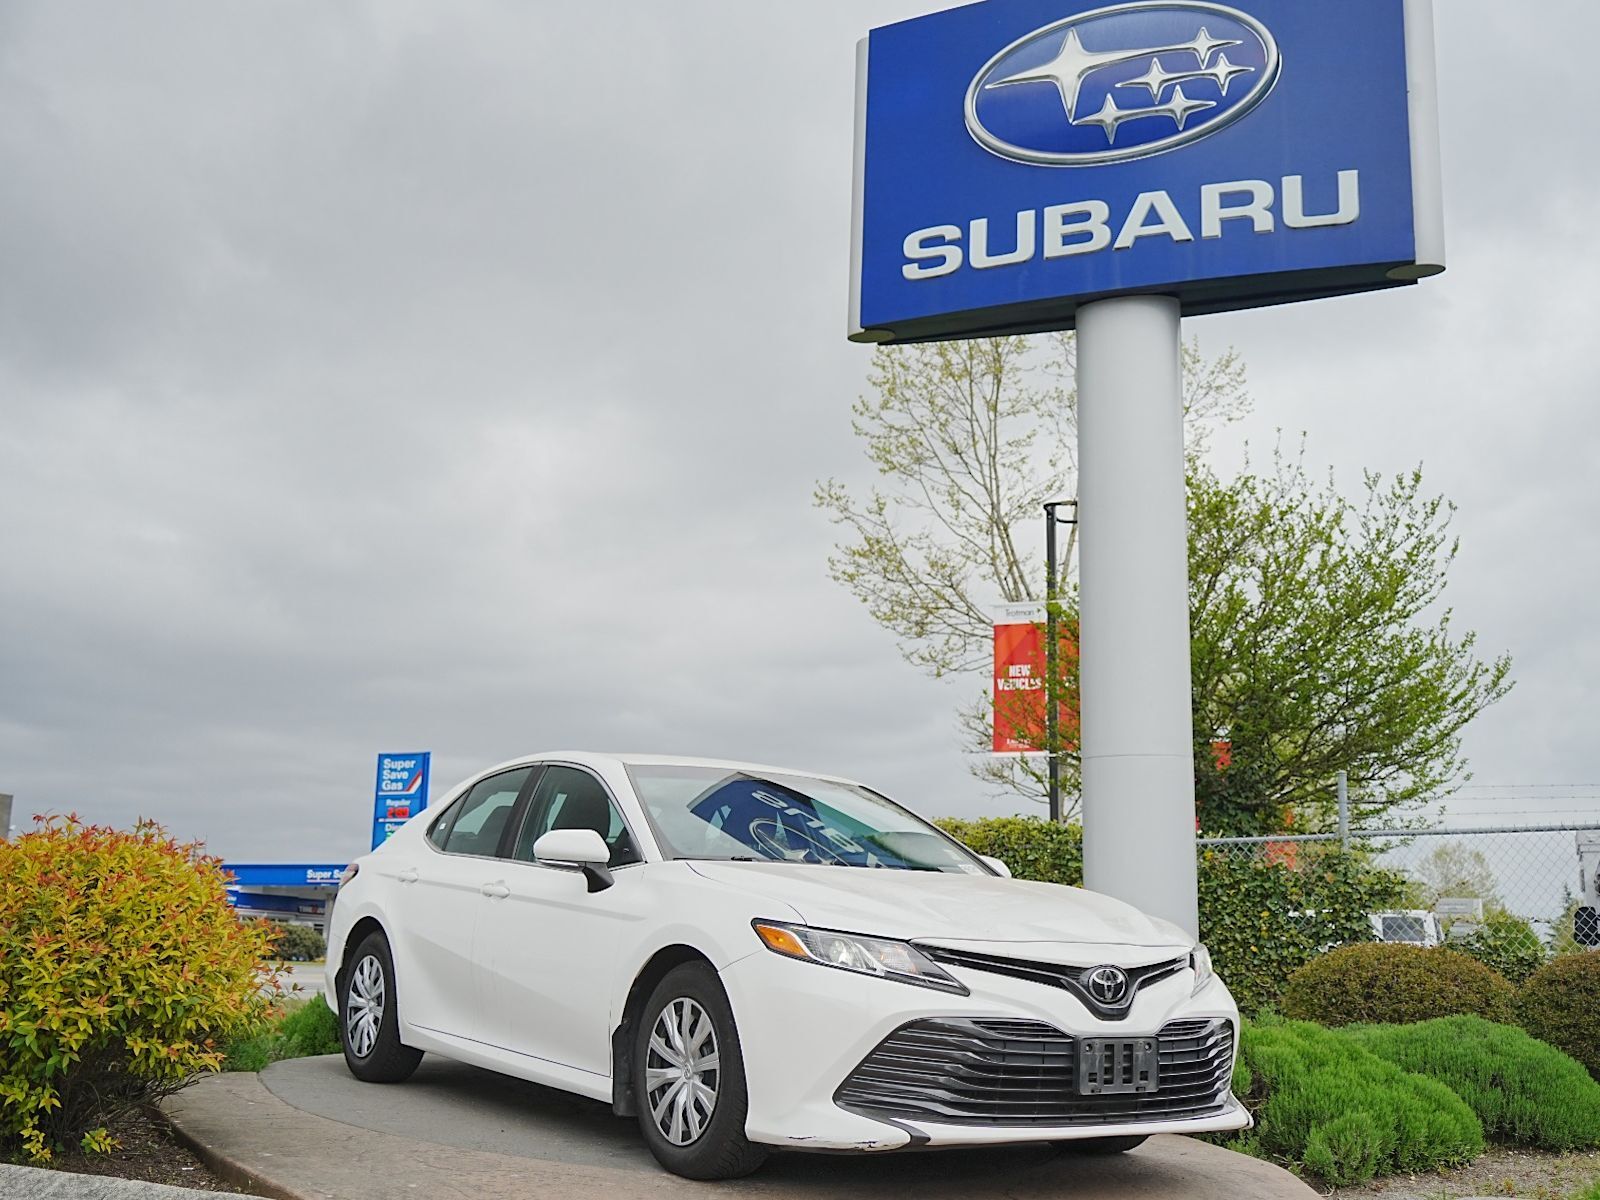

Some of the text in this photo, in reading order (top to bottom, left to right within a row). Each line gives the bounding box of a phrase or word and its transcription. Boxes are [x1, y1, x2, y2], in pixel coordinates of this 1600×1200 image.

[902, 169, 1360, 281] SUBARU
[1009, 664, 1031, 678] NEW
[383, 758, 416, 770] Super
[382, 770, 409, 779] Save
[382, 780, 403, 790] Gas
[306, 869, 332, 879] Super
